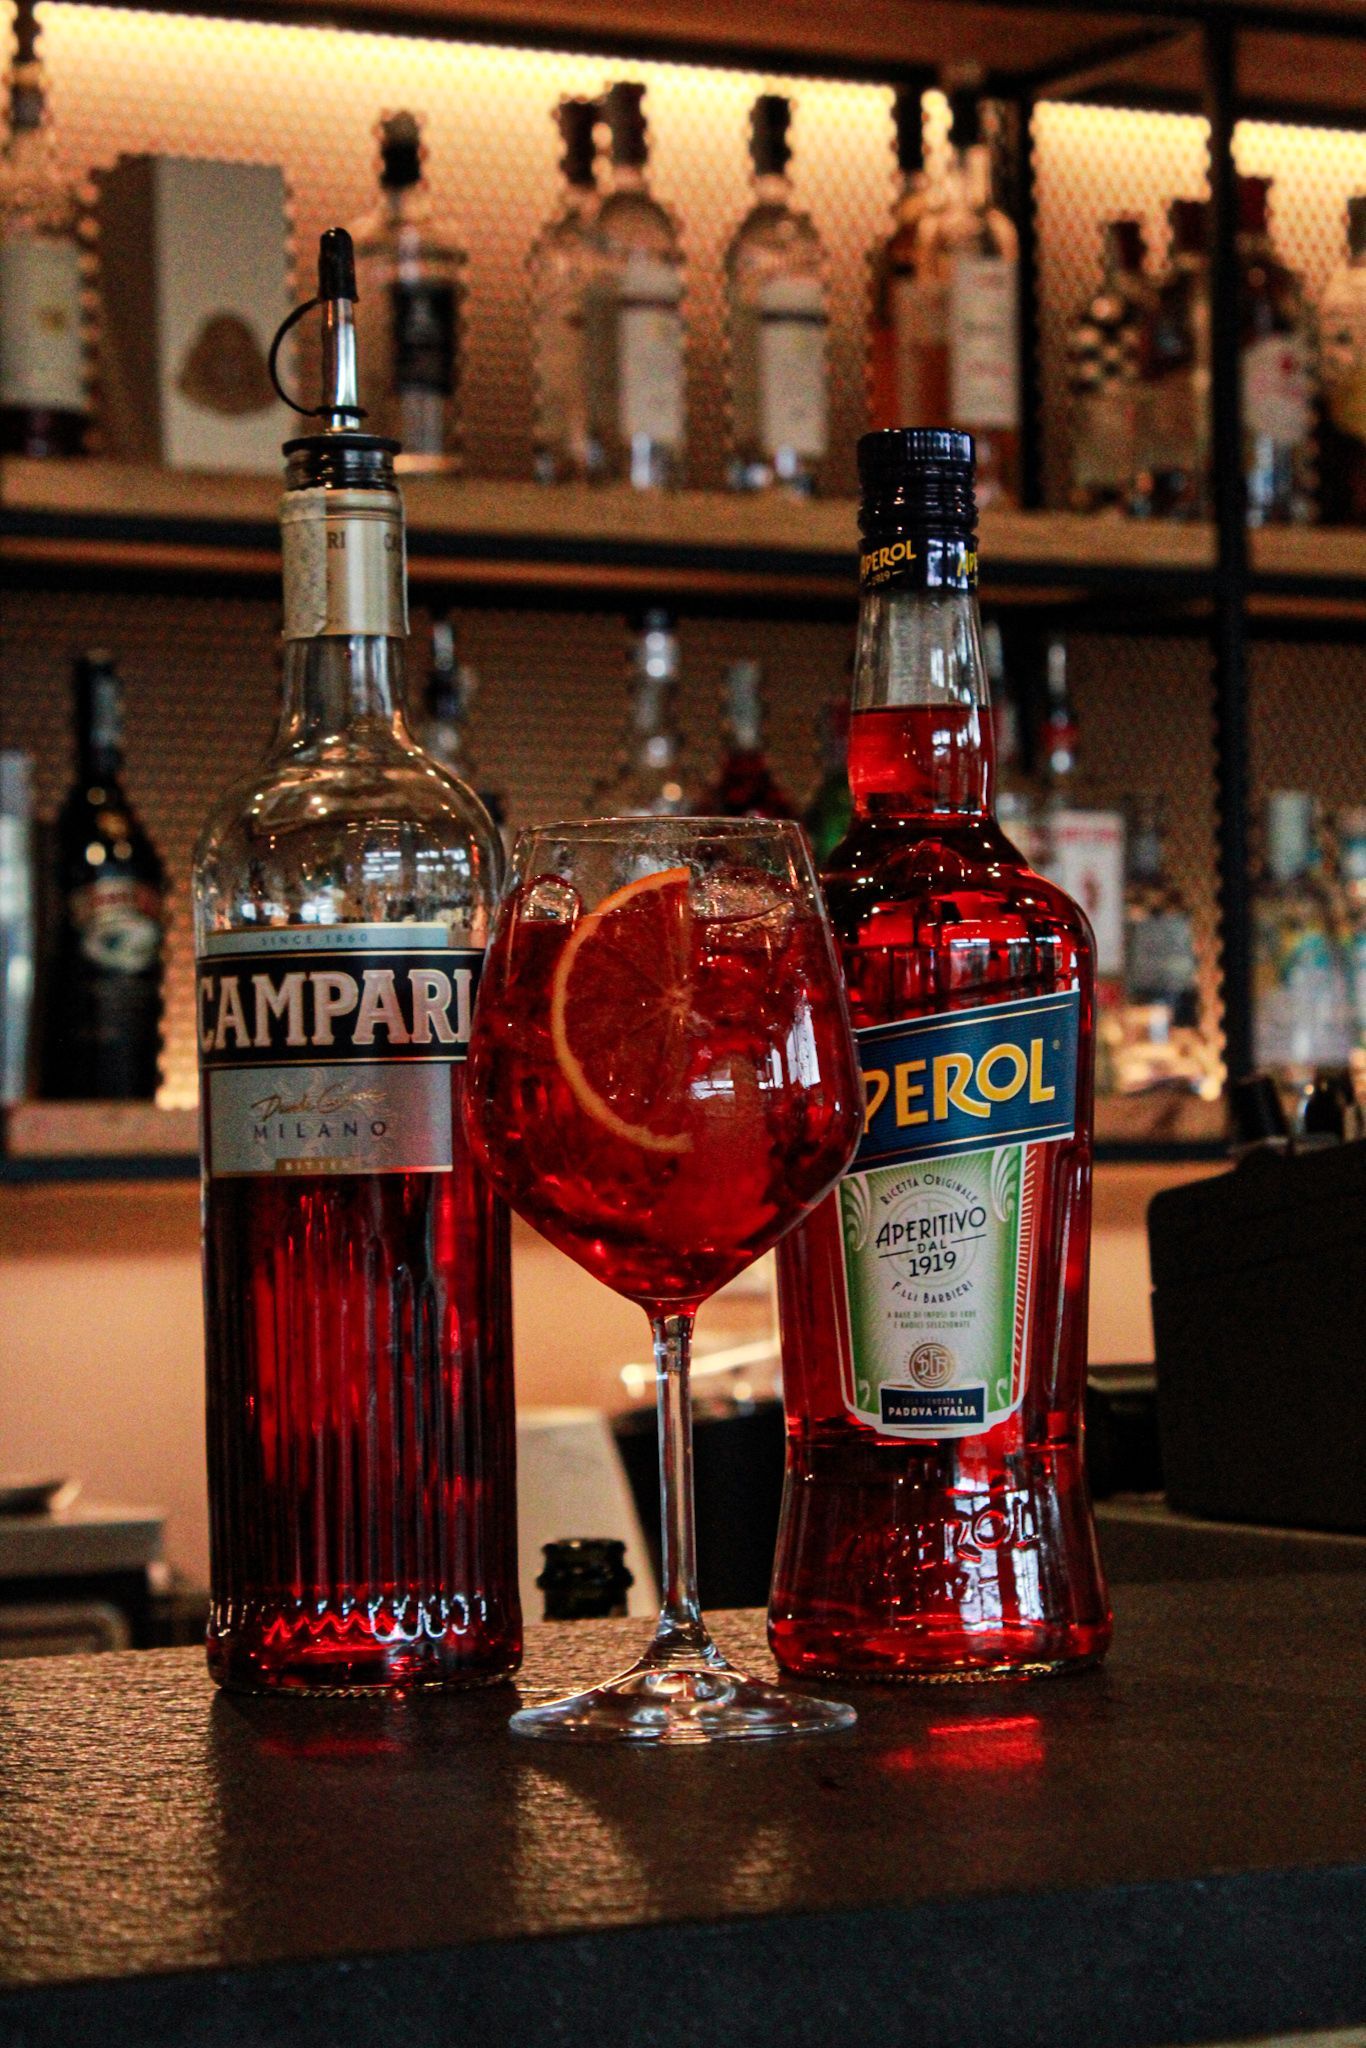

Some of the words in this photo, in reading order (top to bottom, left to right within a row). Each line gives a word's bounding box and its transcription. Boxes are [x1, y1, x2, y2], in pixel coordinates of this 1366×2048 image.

[260, 934, 312, 946] SINCE
[325, 933, 368, 944] 1860
[199, 968, 473, 1054] CAMPARI
[861, 1038, 1056, 1134] PEROL
[253, 1121, 387, 1139] MILANO
[880, 1177, 919, 1205] RICETTA
[923, 1174, 978, 1204] ORIGINALE
[876, 1206, 986, 1248] APERITIVO
[917, 1240, 947, 1254] DAL
[908, 1251, 957, 1278] 1919
[923, 1280, 974, 1304] BARBIERI
